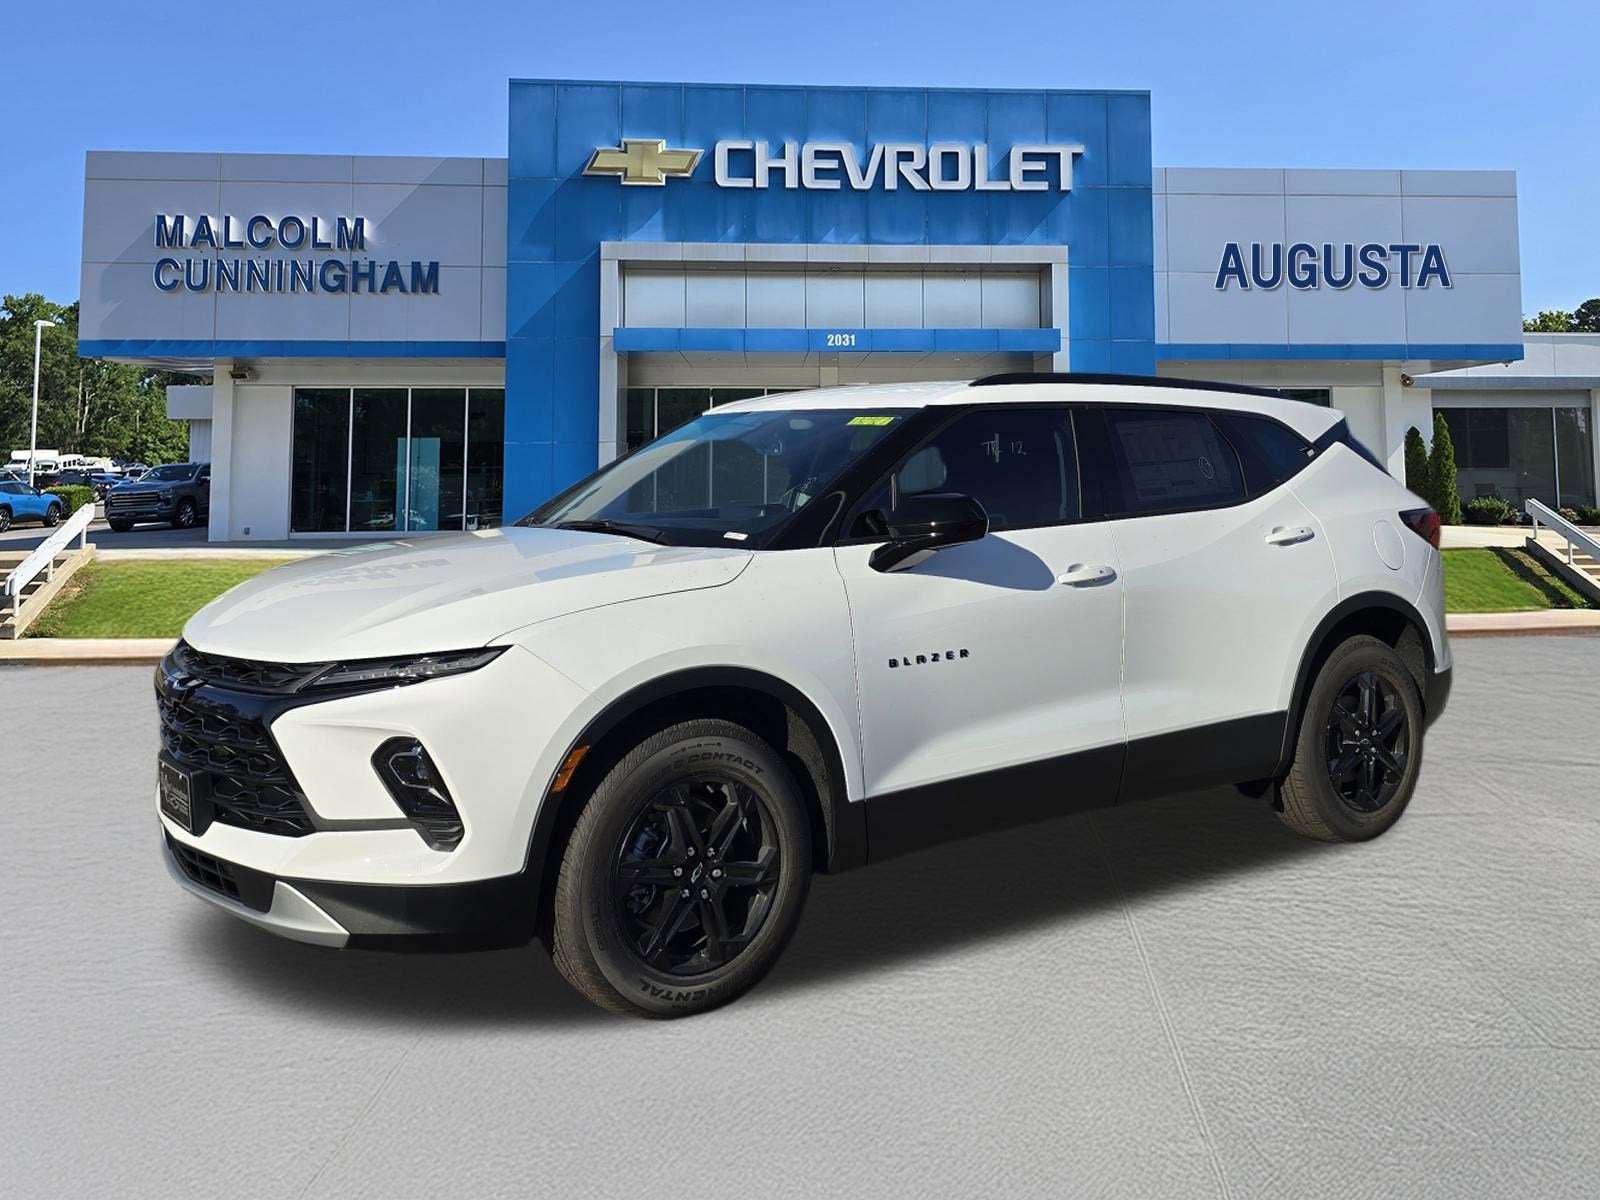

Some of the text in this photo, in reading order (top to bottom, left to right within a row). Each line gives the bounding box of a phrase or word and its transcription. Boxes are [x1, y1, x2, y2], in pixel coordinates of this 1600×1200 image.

[714, 139, 1085, 193] CHEVROLET
[154, 214, 366, 251] MALCOLM
[153, 257, 441, 295] CUNNINGHAM
[1214, 241, 1453, 290] AUGUSTA
[827, 333, 856, 346] 2031
[888, 648, 970, 669] BLAZER
[687, 751, 765, 775] CONTACT
